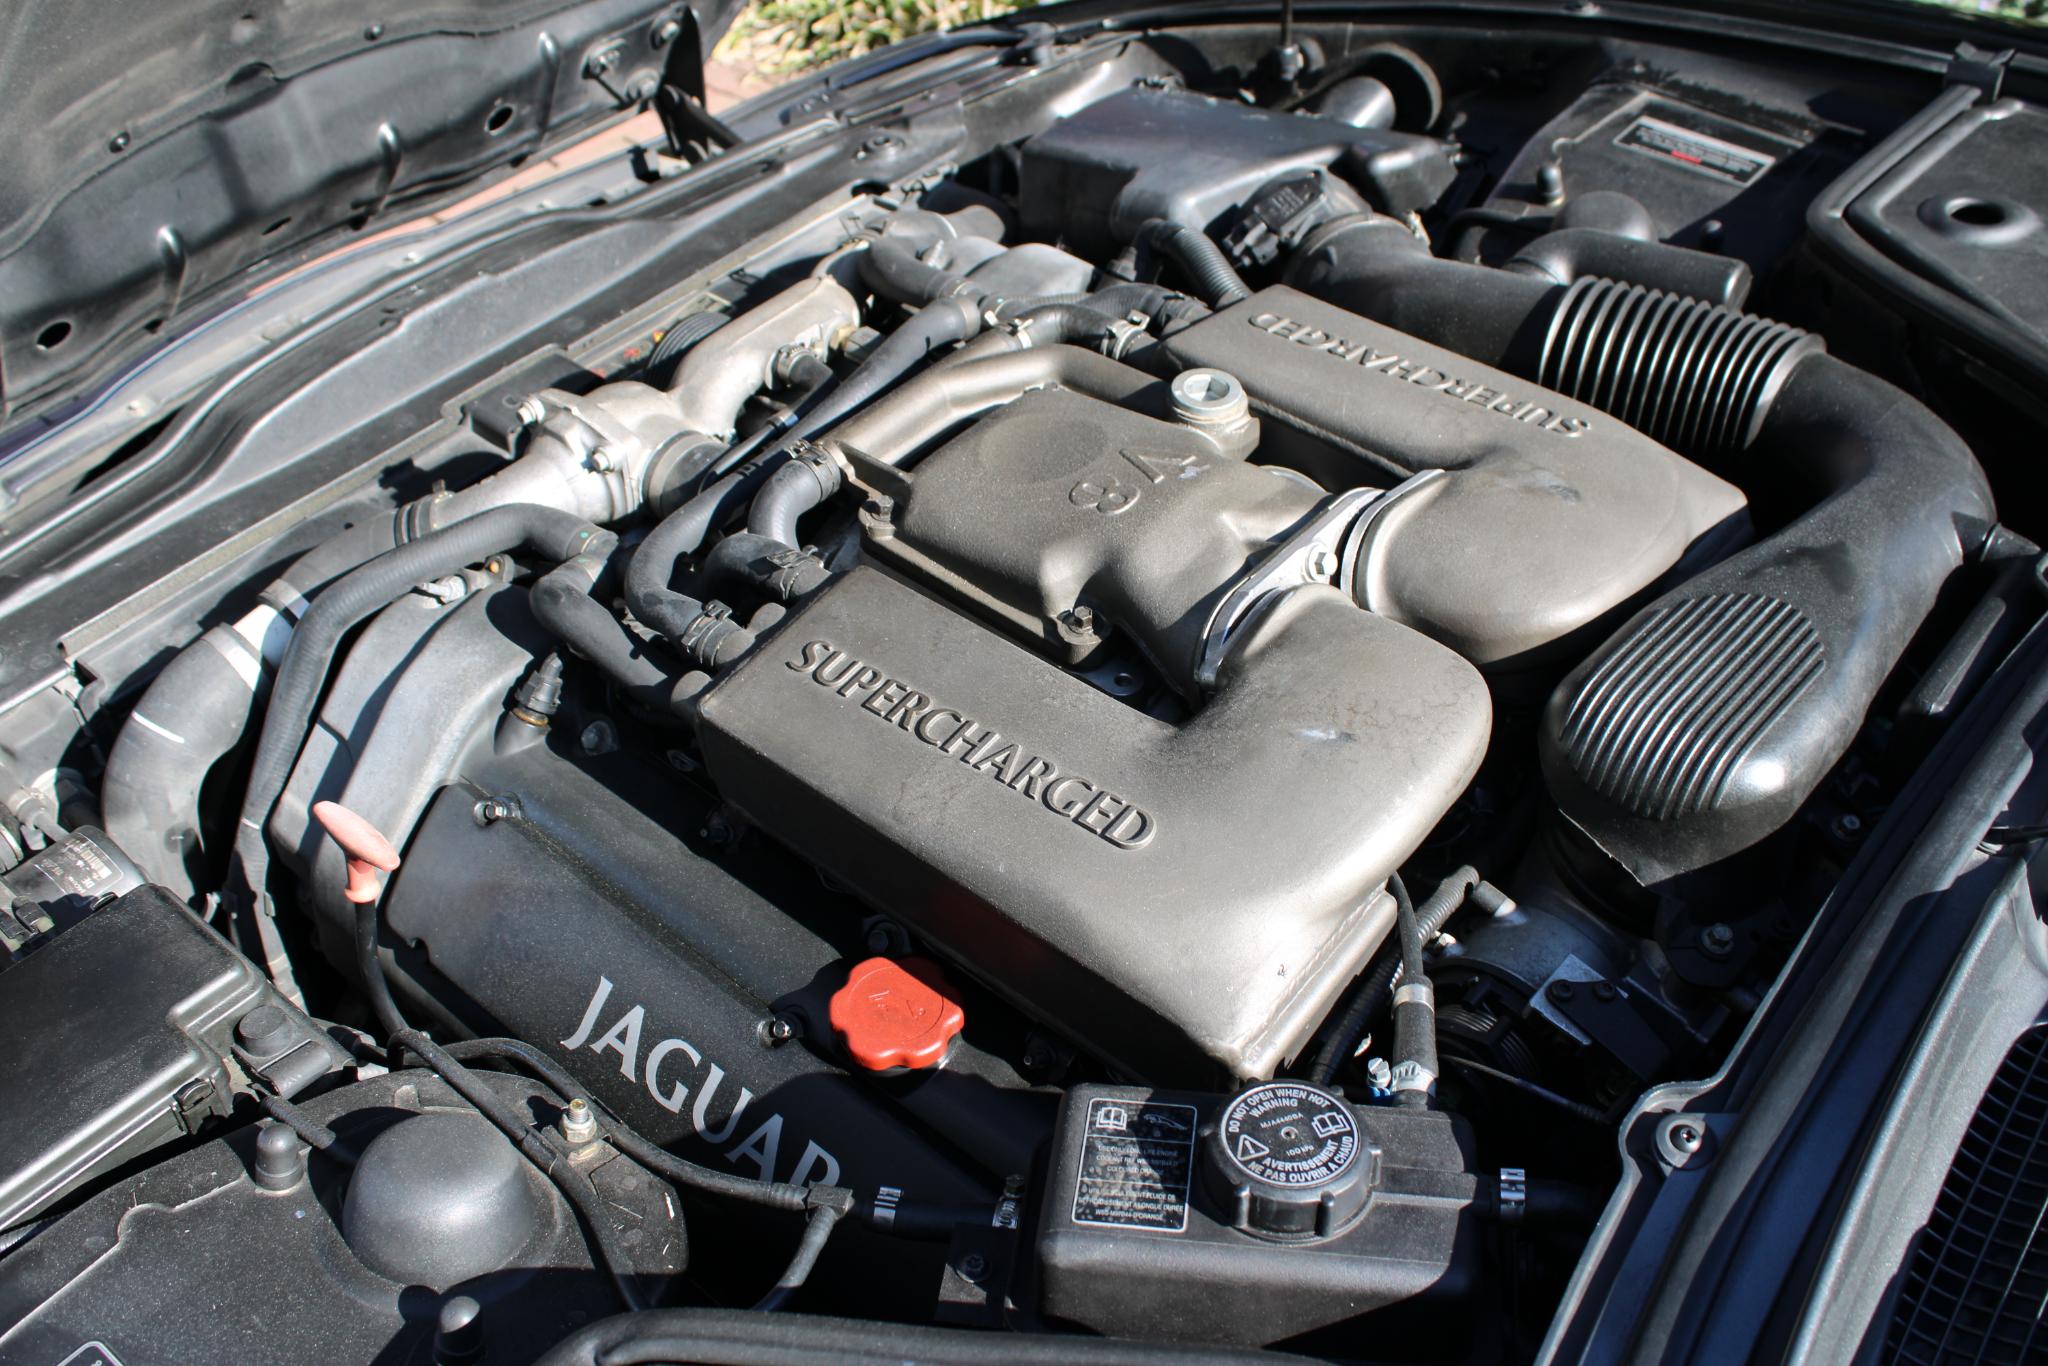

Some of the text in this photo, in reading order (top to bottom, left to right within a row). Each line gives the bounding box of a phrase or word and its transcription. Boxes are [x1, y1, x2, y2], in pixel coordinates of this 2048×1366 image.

[1248, 313, 1592, 437] SUPERCHARGED
[1068, 449, 1197, 516] V8
[785, 640, 1157, 850] SUPERCHARGED
[1228, 1088, 1331, 1133] DO NOT OPEN WHEN HOT
[1249, 1098, 1298, 1118] WARNING
[1248, 1135, 1353, 1183] NE PAS OUVRIR A CHAUD
[1262, 1139, 1339, 1172] AVERTISSEMENT
[1286, 1147, 1300, 1157] 100
